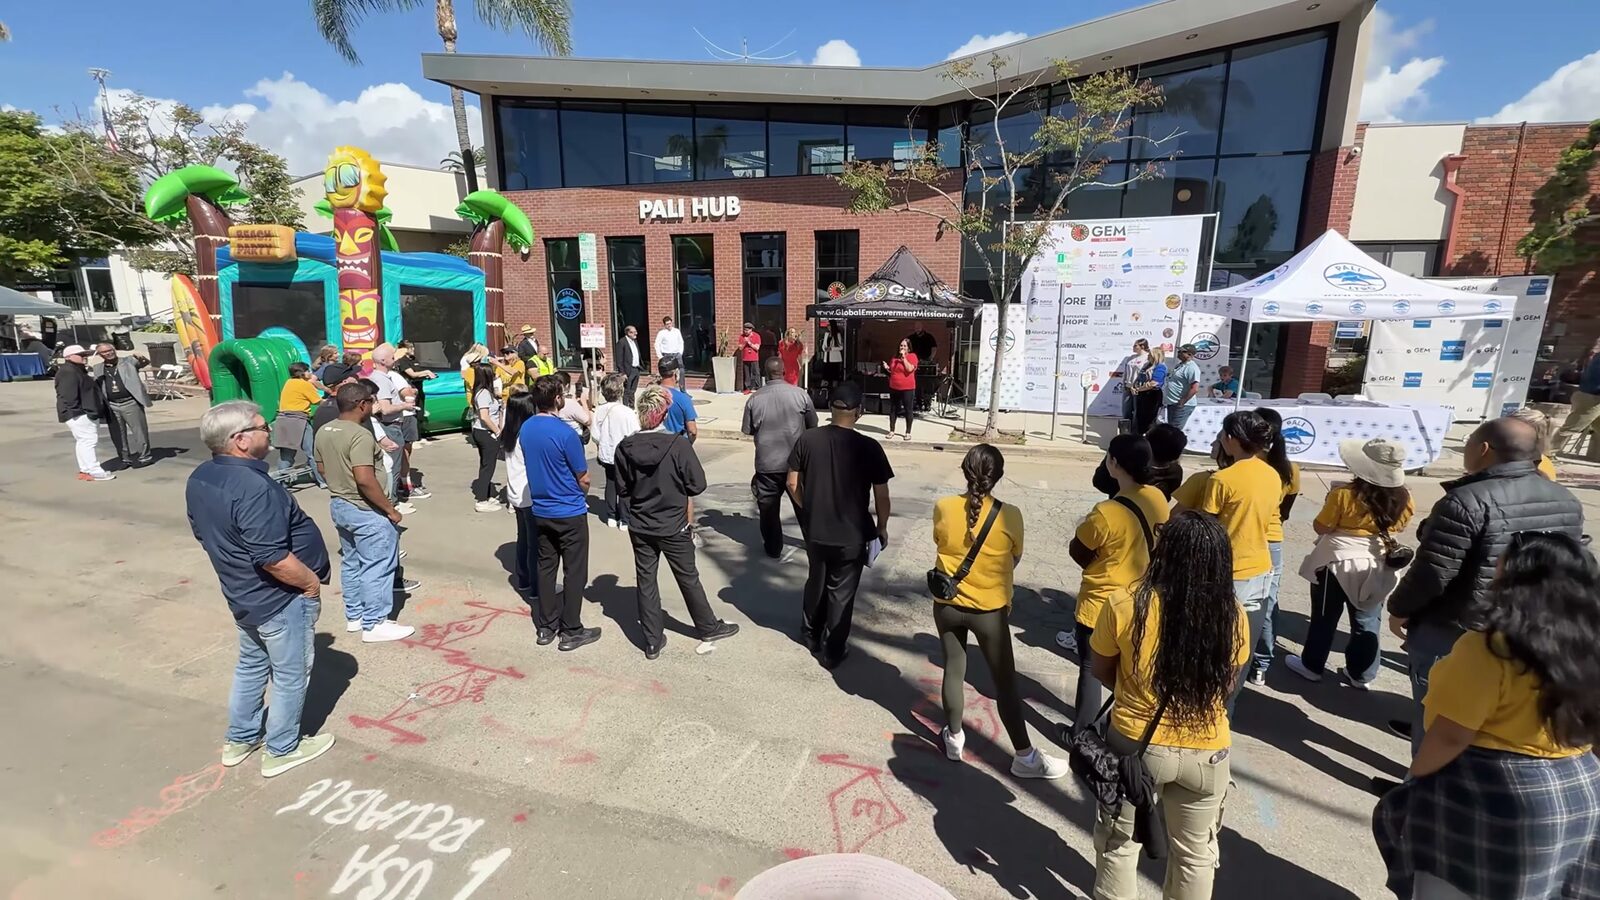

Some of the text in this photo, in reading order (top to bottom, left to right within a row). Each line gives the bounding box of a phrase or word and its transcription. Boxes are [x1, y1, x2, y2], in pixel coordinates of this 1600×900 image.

[639, 196, 741, 220] PALI HUB
[236, 230, 272, 241] BEACH
[1092, 226, 1126, 237] GEM
[237, 243, 272, 255] PARTY
[889, 284, 930, 300] GEM
[816, 308, 963, 319] www.GlobalEmpowermentMission.org
[275, 778, 485, 853] RELIABLE
[330, 844, 434, 900] USA
